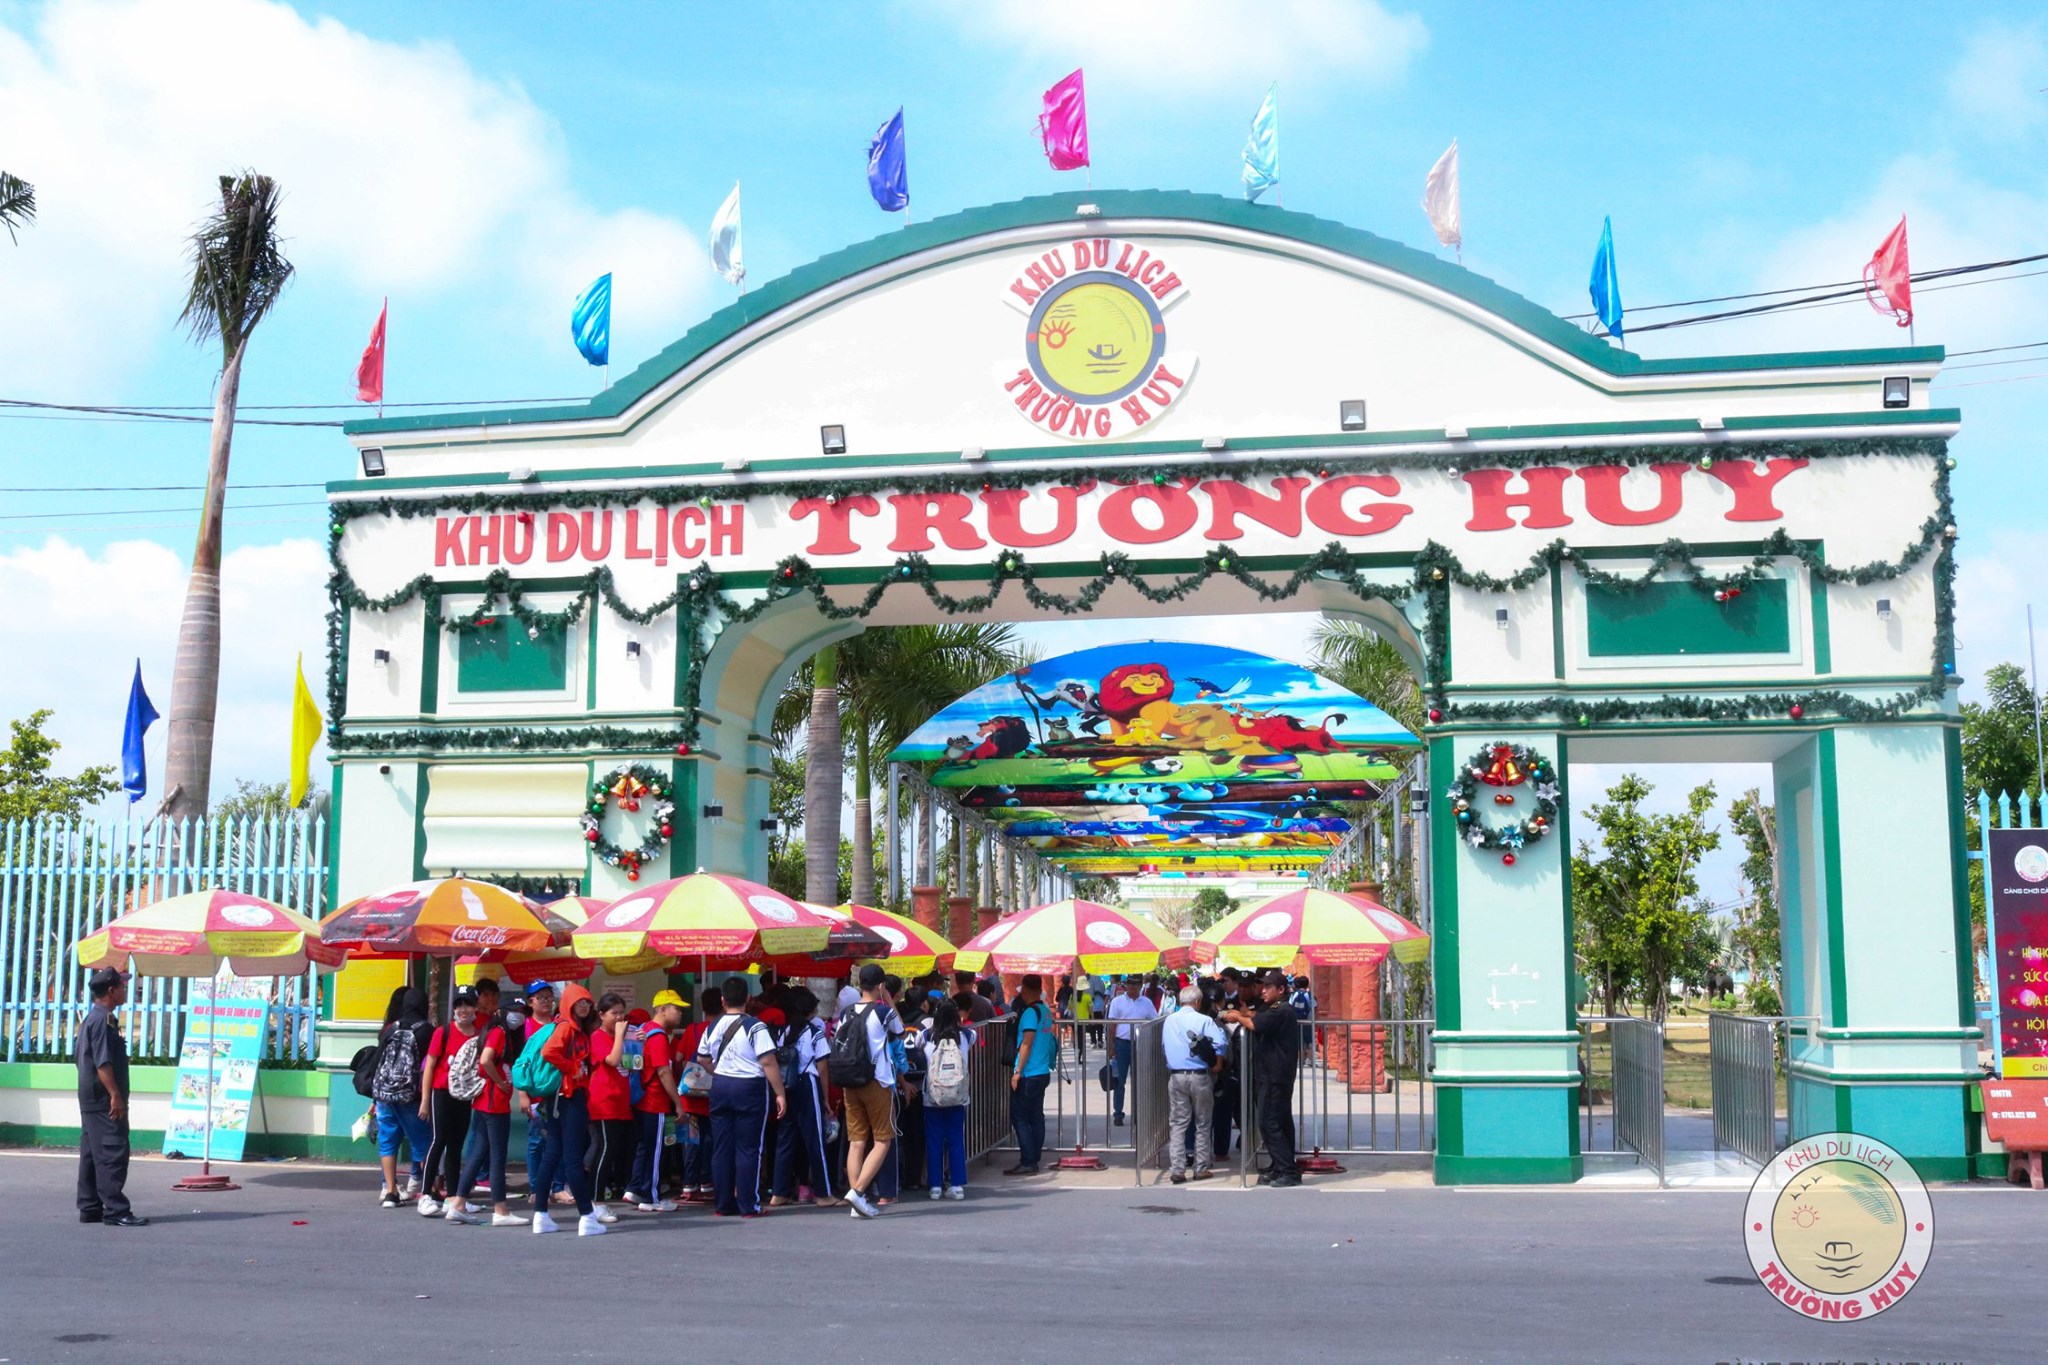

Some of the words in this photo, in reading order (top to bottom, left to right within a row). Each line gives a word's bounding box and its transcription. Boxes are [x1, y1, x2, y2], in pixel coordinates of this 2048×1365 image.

[1010, 249, 1067, 305] KHU
[1072, 238, 1111, 271] DU
[1115, 243, 1183, 300] LỊCH
[1004, 368, 1112, 437] TRƯỜNG
[1120, 363, 1185, 426] HUY
[1462, 457, 1810, 532] HUY
[434, 512, 535, 567] KHU
[546, 509, 613, 563] DU
[624, 505, 744, 567] LỊCH
[2023, 968, 2042, 982] SÚC
[2026, 1016, 2045, 1032] HỘI
